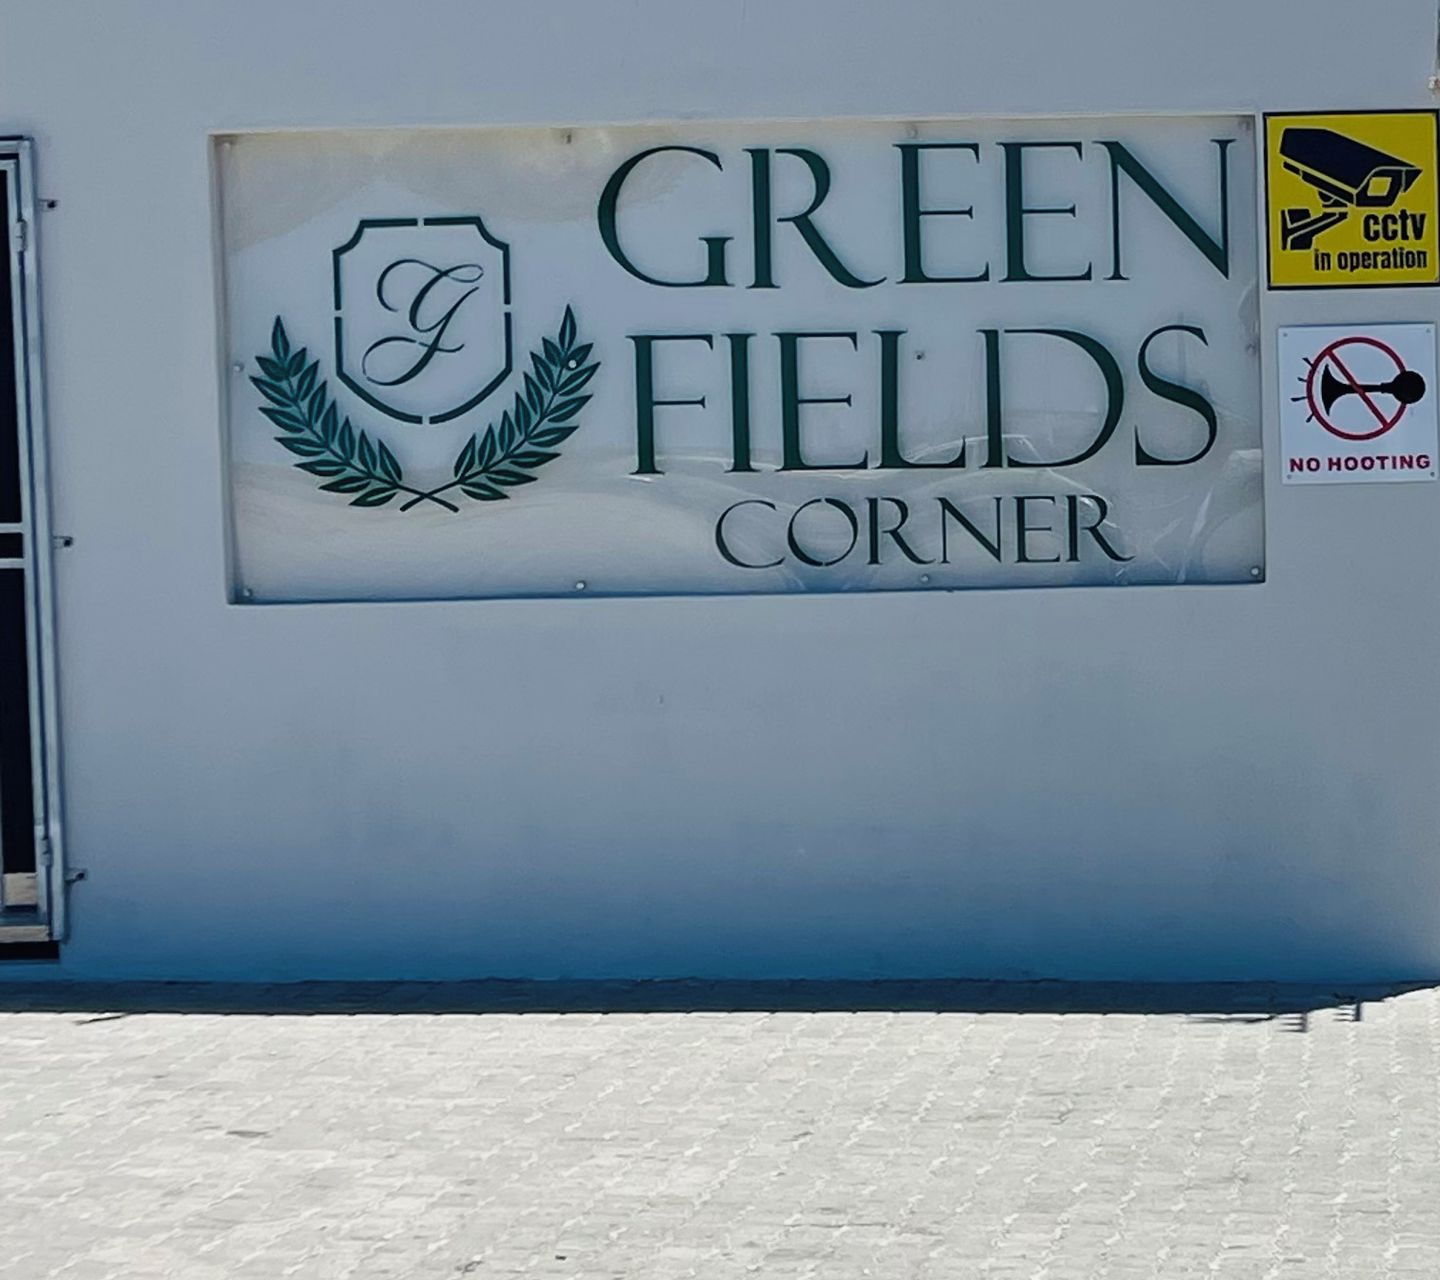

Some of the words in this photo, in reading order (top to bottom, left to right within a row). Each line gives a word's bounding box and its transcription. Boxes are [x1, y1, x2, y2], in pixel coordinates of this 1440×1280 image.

[597, 138, 1235, 290] GREEN
[1363, 209, 1426, 242] cctv
[1314, 248, 1331, 271] in
[1337, 246, 1428, 272] operation
[627, 323, 1220, 476] FIELDS
[1289, 457, 1321, 473] NO
[1327, 454, 1431, 472] HOOTING
[715, 494, 1134, 571] CORNER
